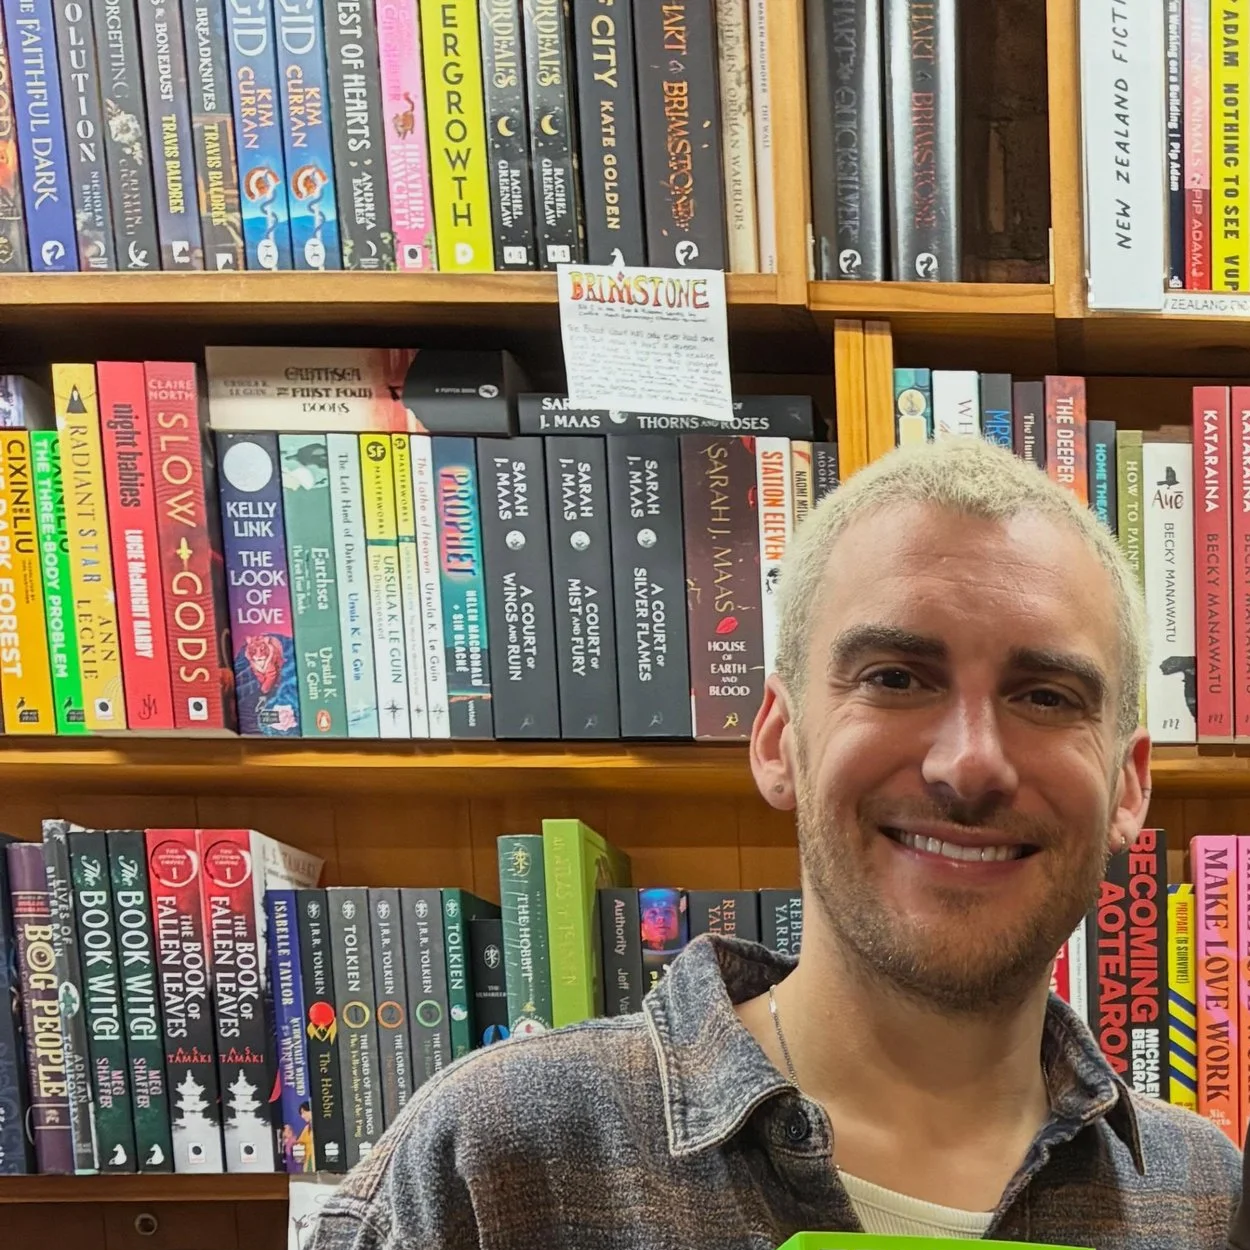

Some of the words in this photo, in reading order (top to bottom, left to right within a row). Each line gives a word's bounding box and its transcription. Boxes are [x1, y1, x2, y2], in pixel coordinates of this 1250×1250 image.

[591, 15, 619, 88] CITY
[1222, 10, 1239, 67] ADAM
[17, 19, 50, 131] FAITHFUL
[600, 101, 615, 147] KATE
[1113, 78, 1131, 184] ZEALAND
[1223, 84, 1239, 158] NOTHING
[31, 137, 58, 210] DARK
[1223, 175, 1238, 199] TO
[1117, 200, 1132, 249] NEW
[1223, 205, 1239, 240] SEE
[568, 271, 709, 309] BRIMSTONE
[148, 379, 194, 389] CLAIRE
[148, 389, 196, 400] NORTH
[554, 416, 600, 428] MAAS
[637, 416, 699, 429] THORNS
[720, 417, 770, 430] ROSES
[6, 439, 29, 506] CIXIN
[157, 412, 197, 528] SLOW
[761, 451, 785, 508] STATION
[1203, 409, 1221, 513] KATARAINA
[226, 502, 277, 519] KELLY
[512, 461, 529, 517] SARAH
[16, 516, 34, 555] LIU
[234, 520, 274, 537] LINK
[763, 511, 786, 561] ELEVEN
[231, 569, 286, 587] LOOK
[238, 551, 273, 566] THE
[1207, 533, 1221, 588] BECKY
[237, 608, 284, 624] LOVE
[246, 589, 272, 605] OF
[503, 572, 518, 625] WINGS
[568, 579, 581, 615] MIST
[633, 567, 648, 619] SILVER
[1, 572, 22, 679] FOREST
[172, 571, 210, 683] GODS
[638, 623, 652, 682] FLAMES
[708, 641, 747, 651] HOUSE
[1208, 592, 1222, 694] MANAWATU
[508, 645, 523, 681] RUIN
[572, 636, 586, 677] FURY
[711, 663, 747, 674] EARTH
[709, 686, 750, 696] BLOOD
[1204, 848, 1228, 931] MAKE
[80, 890, 113, 967] BOOK
[156, 896, 182, 966] FALLEN
[613, 899, 625, 956] Authority
[1128, 830, 1159, 1024] BECOMING
[342, 925, 361, 993] TOLKIEN
[1205, 940, 1230, 1012] LOVE
[87, 973, 120, 1041] WITCH
[162, 971, 187, 1038] LEAVES
[1206, 1020, 1230, 1104] WORK
